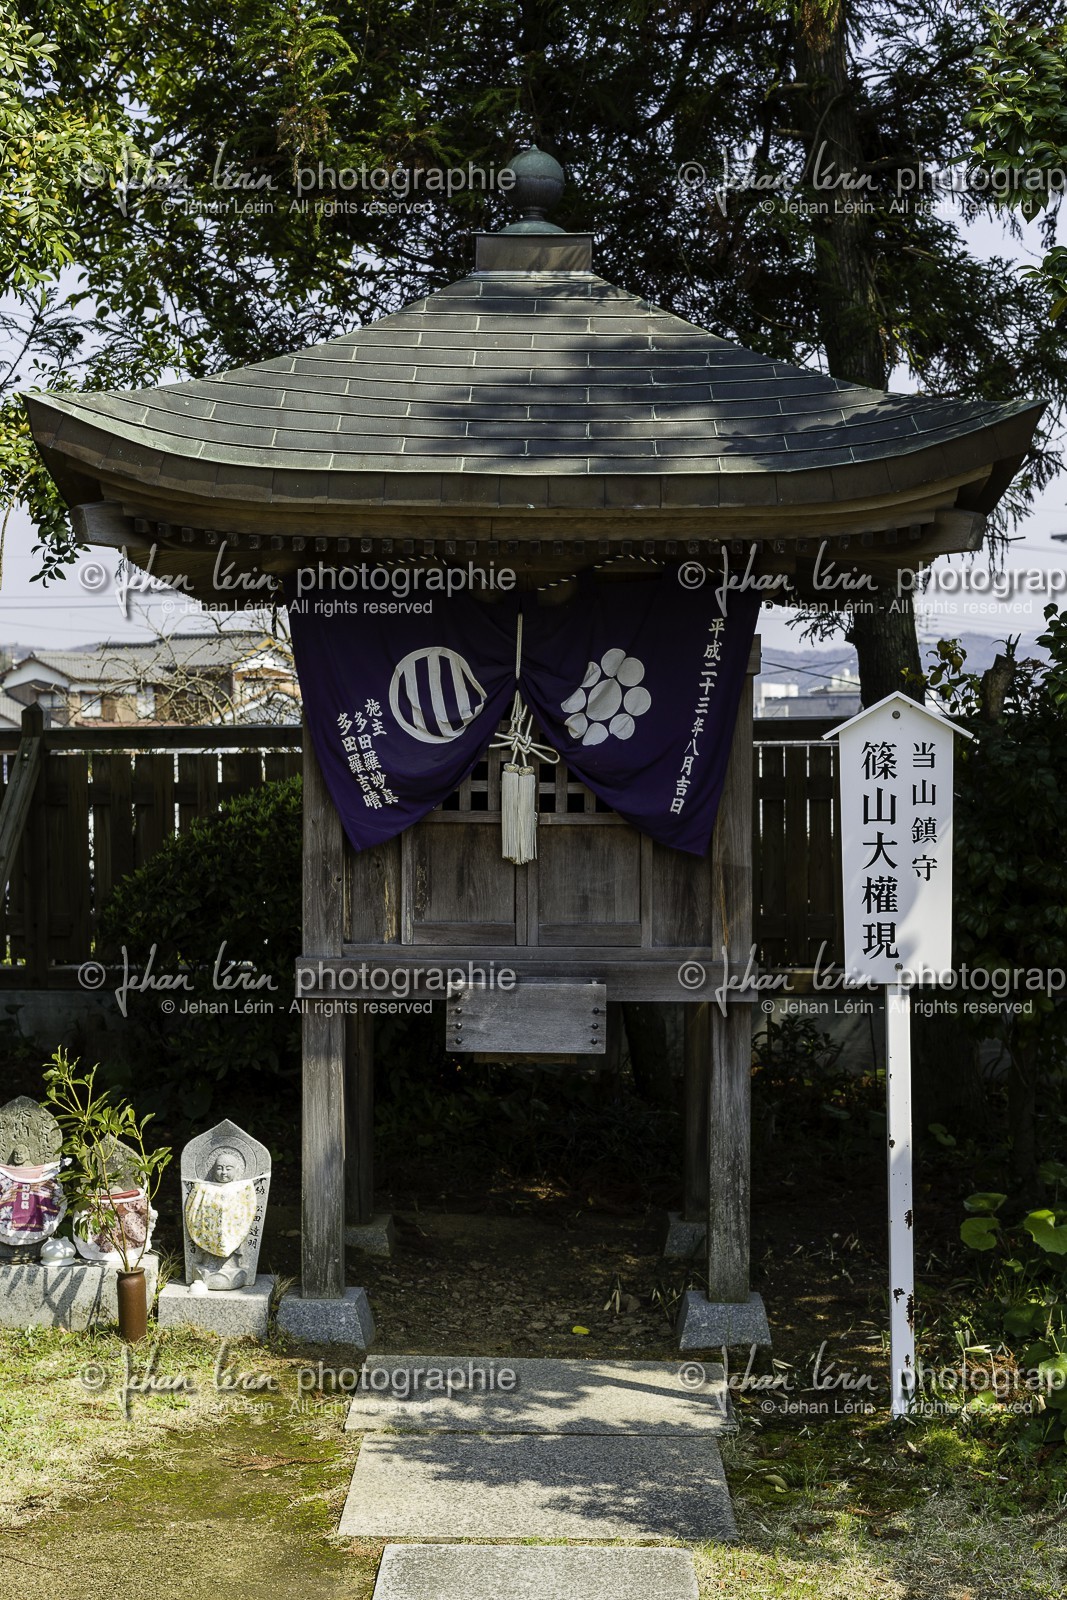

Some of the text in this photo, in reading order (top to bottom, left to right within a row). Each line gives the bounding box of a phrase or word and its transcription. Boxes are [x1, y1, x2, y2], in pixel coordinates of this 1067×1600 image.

[336, 712, 383, 810] 多田羅吉晴
[354, 711, 399, 805] 多田羅妙真
[364, 698, 387, 737] 施主
[670, 618, 726, 815] 平成二十三年八月吉日
[861, 741, 900, 960] 篠山大權現
[910, 741, 938, 881] 当山鎮守
